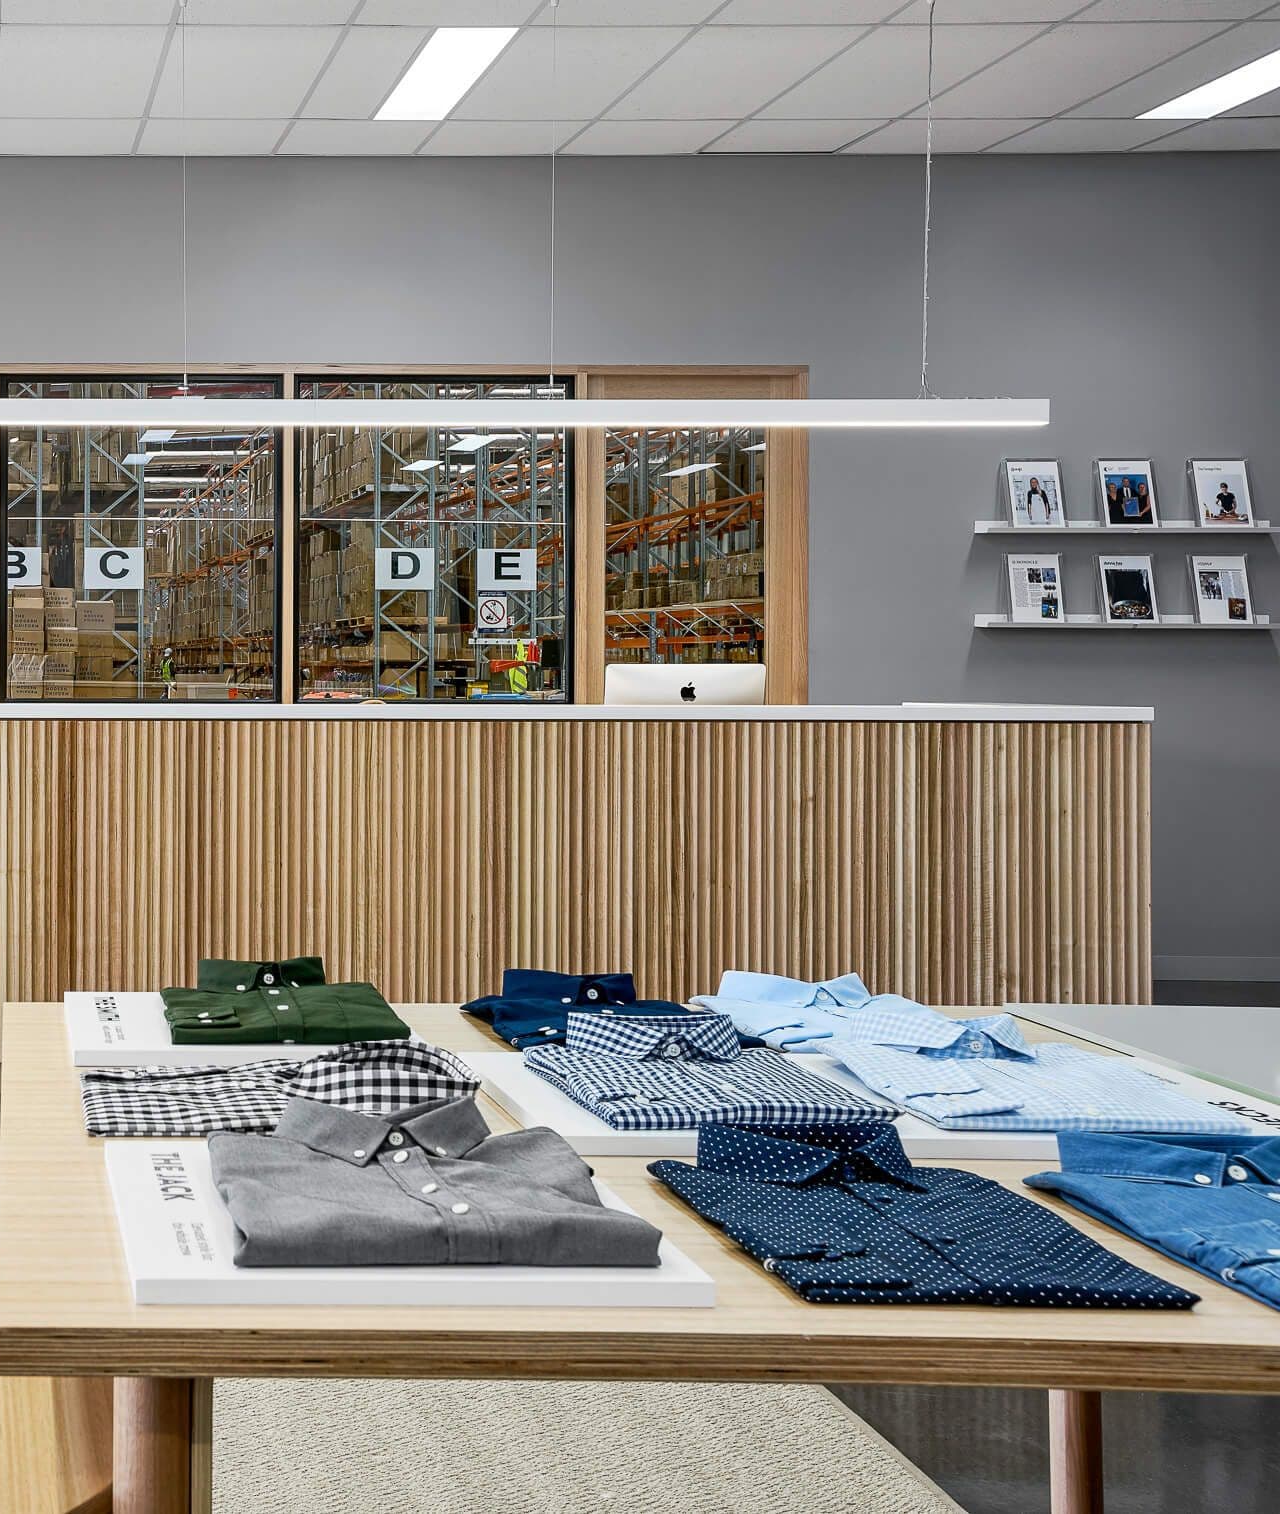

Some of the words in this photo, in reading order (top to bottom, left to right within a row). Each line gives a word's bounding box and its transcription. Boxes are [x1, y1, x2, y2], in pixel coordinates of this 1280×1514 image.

[7, 550, 28, 579] B
[99, 550, 129, 579] C
[391, 551, 421, 580] D
[494, 551, 521, 580] E
[150, 1152, 185, 1171] THE
[155, 1173, 196, 1201] JACK
